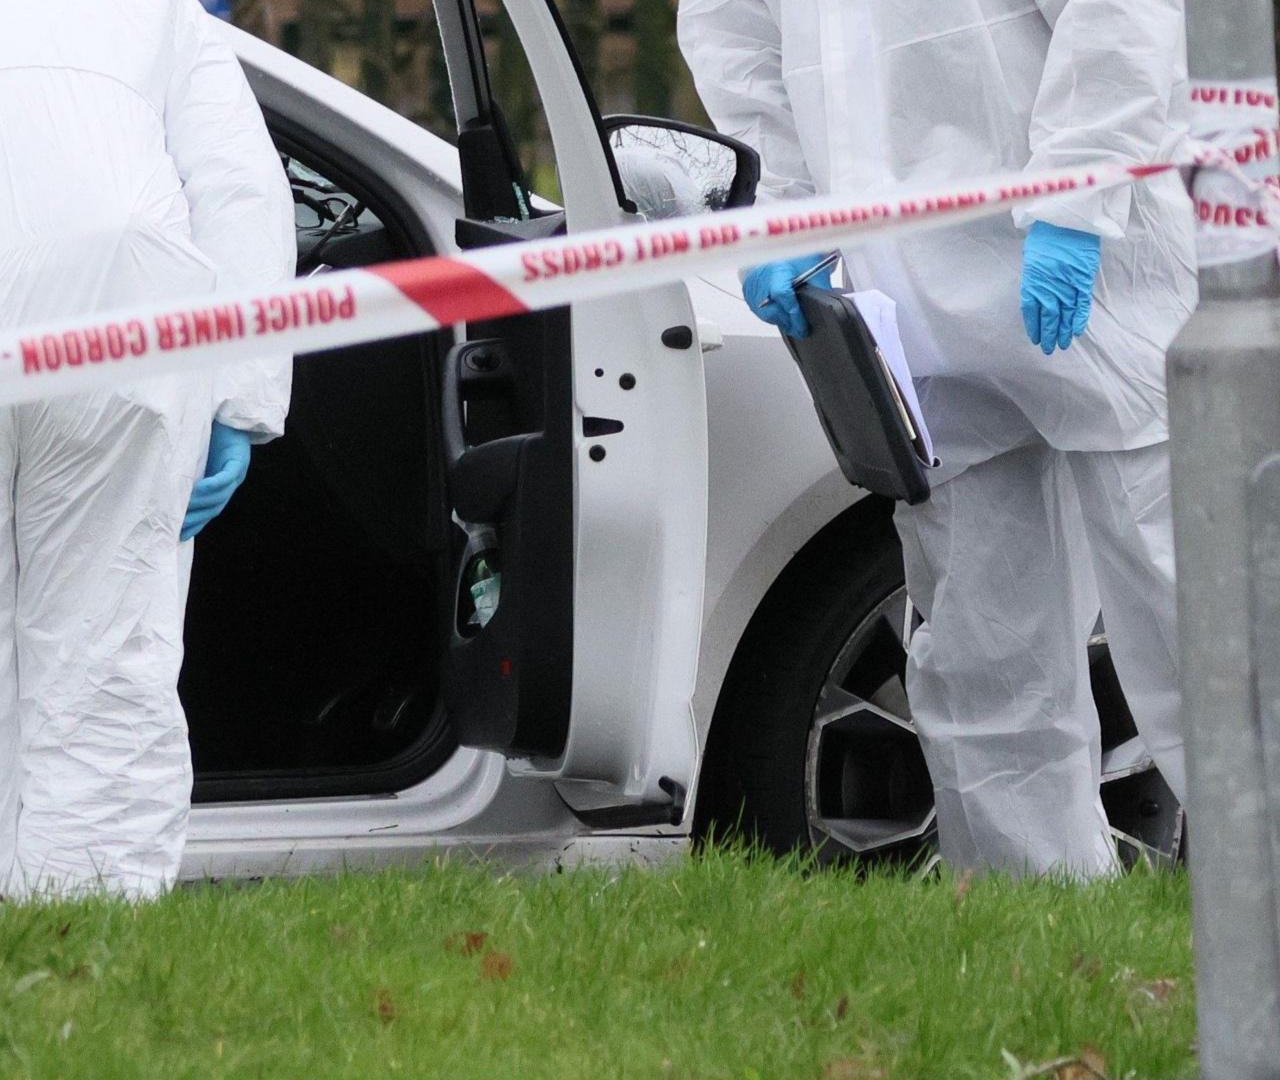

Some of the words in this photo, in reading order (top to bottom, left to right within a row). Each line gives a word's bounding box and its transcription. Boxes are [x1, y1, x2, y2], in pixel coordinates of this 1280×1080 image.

[156, 306, 247, 353] INNER
[254, 288, 359, 337] POLICE
[21, 322, 150, 375] CORDON
